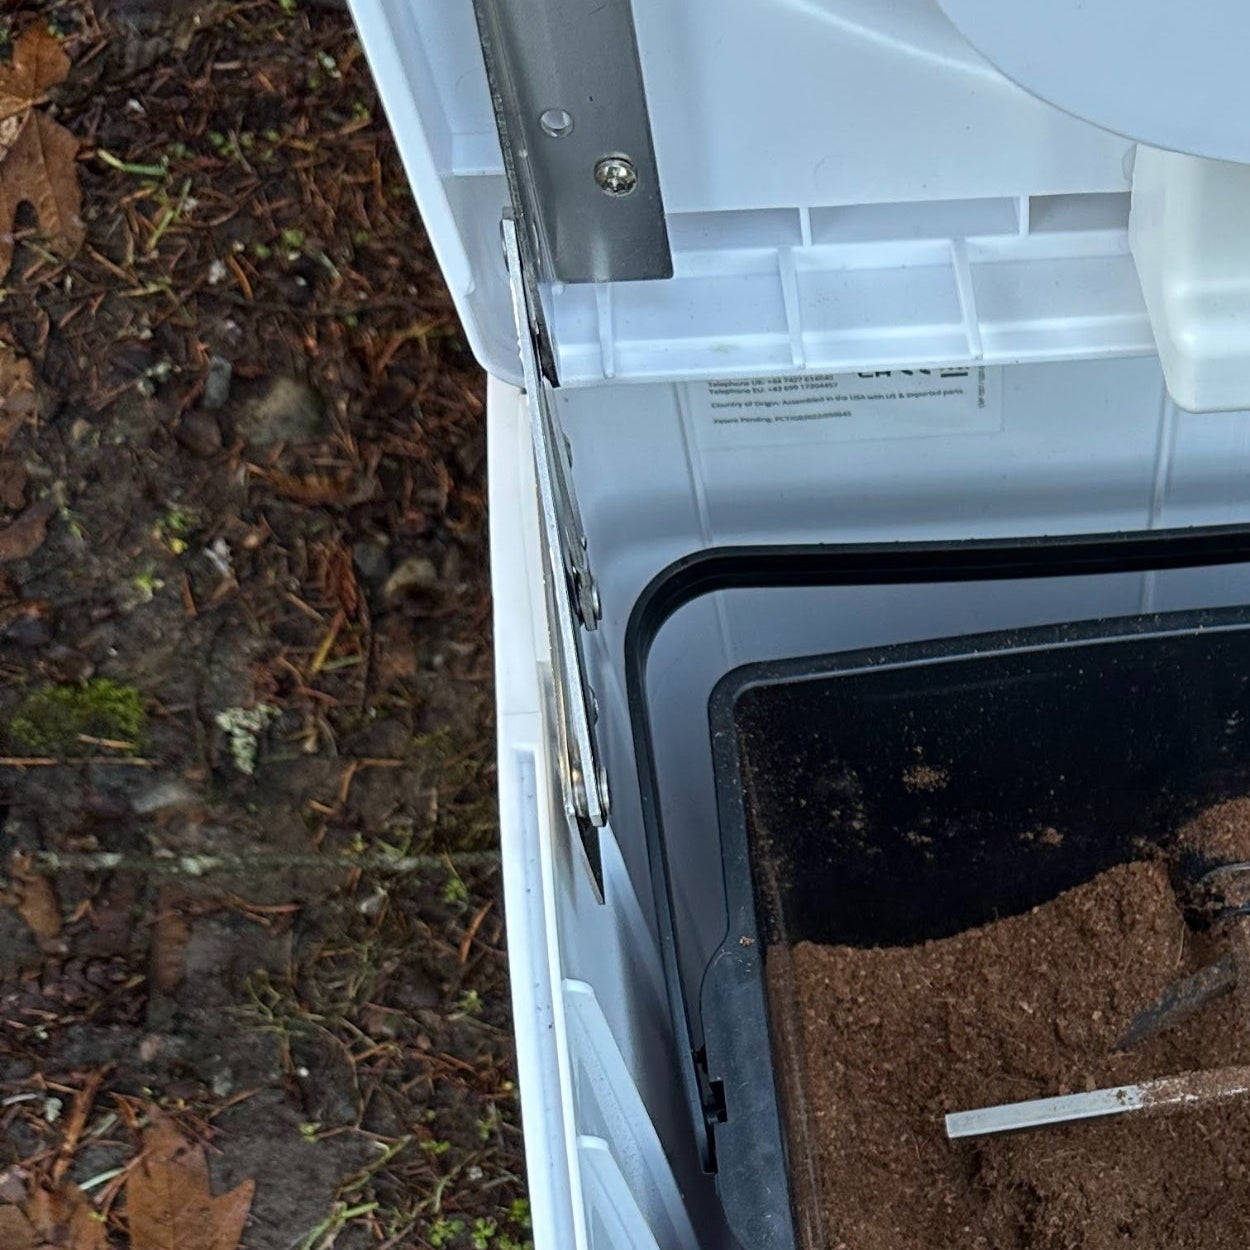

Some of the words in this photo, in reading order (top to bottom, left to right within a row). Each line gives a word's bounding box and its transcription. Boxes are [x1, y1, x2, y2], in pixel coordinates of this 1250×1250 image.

[708, 387, 750, 395] Telephone
[711, 401, 742, 409] Country
[782, 397, 825, 405] Assembled
[848, 393, 866, 401] USA
[898, 391, 905, 399] &
